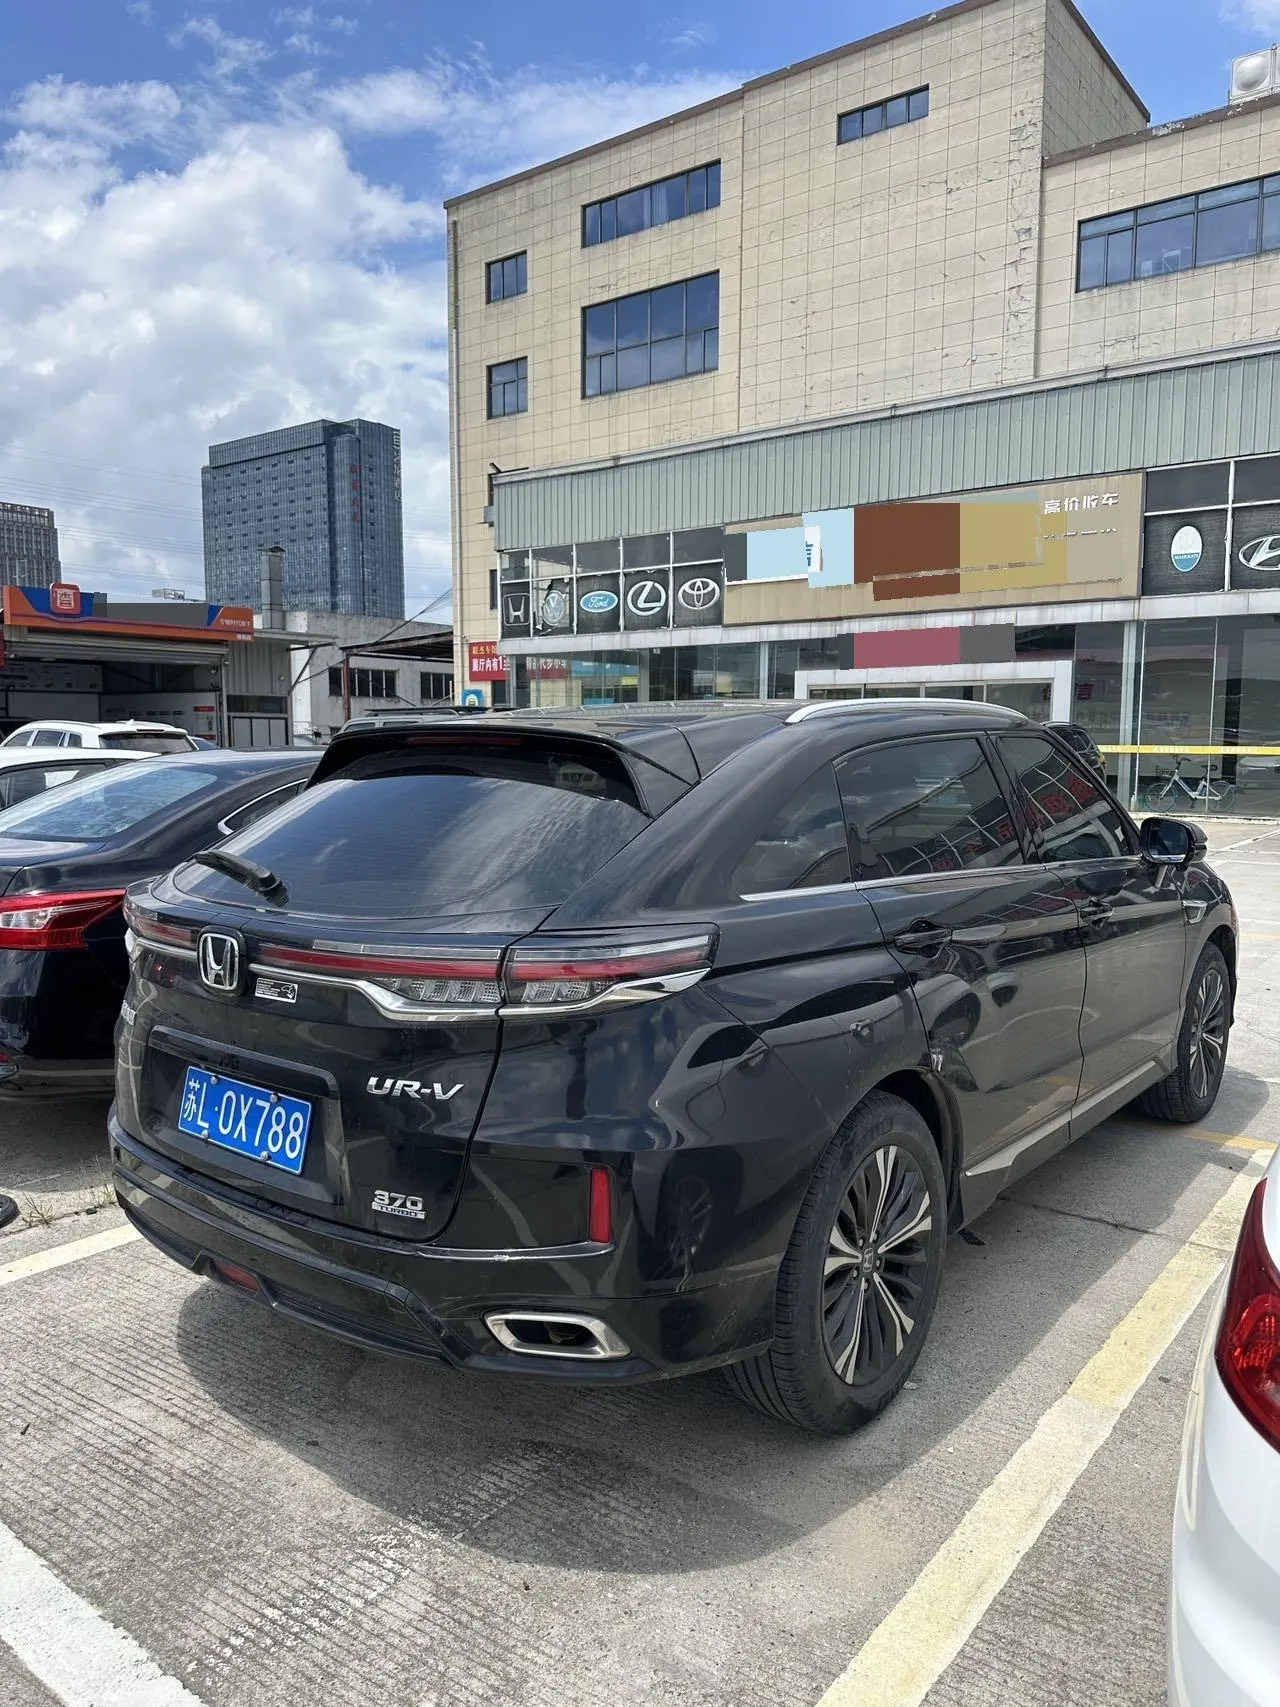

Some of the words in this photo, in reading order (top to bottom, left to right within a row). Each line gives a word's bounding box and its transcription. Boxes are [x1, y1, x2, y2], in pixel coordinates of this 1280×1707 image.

[588, 596, 610, 608] Ford
[366, 1076, 465, 1100] UR-V
[373, 1189, 424, 1211] 370
[379, 1204, 419, 1218] TURBO
